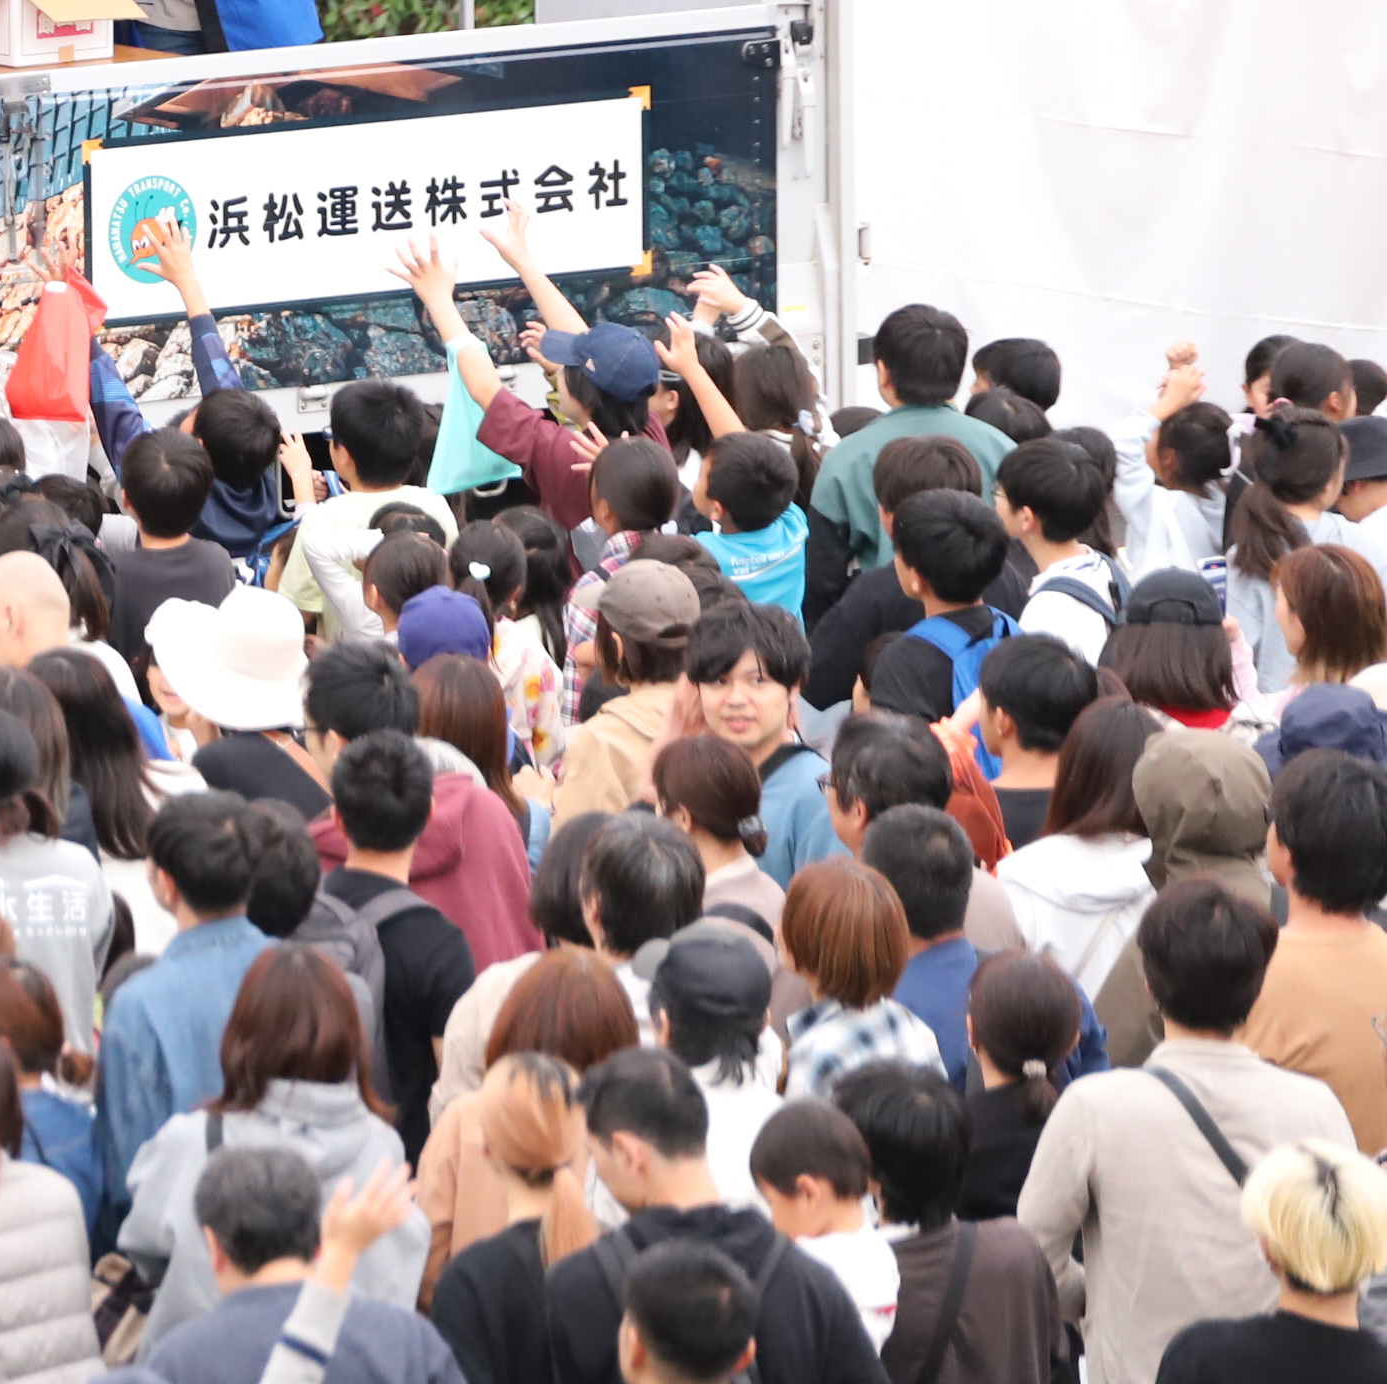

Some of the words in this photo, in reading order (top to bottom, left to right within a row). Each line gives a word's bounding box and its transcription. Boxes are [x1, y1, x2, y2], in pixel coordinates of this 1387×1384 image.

[110, 198, 129, 264] HAMAMATSU
[127, 177, 182, 198] TRANSPORT
[206, 158, 629, 249] 浜松運送株式会社
